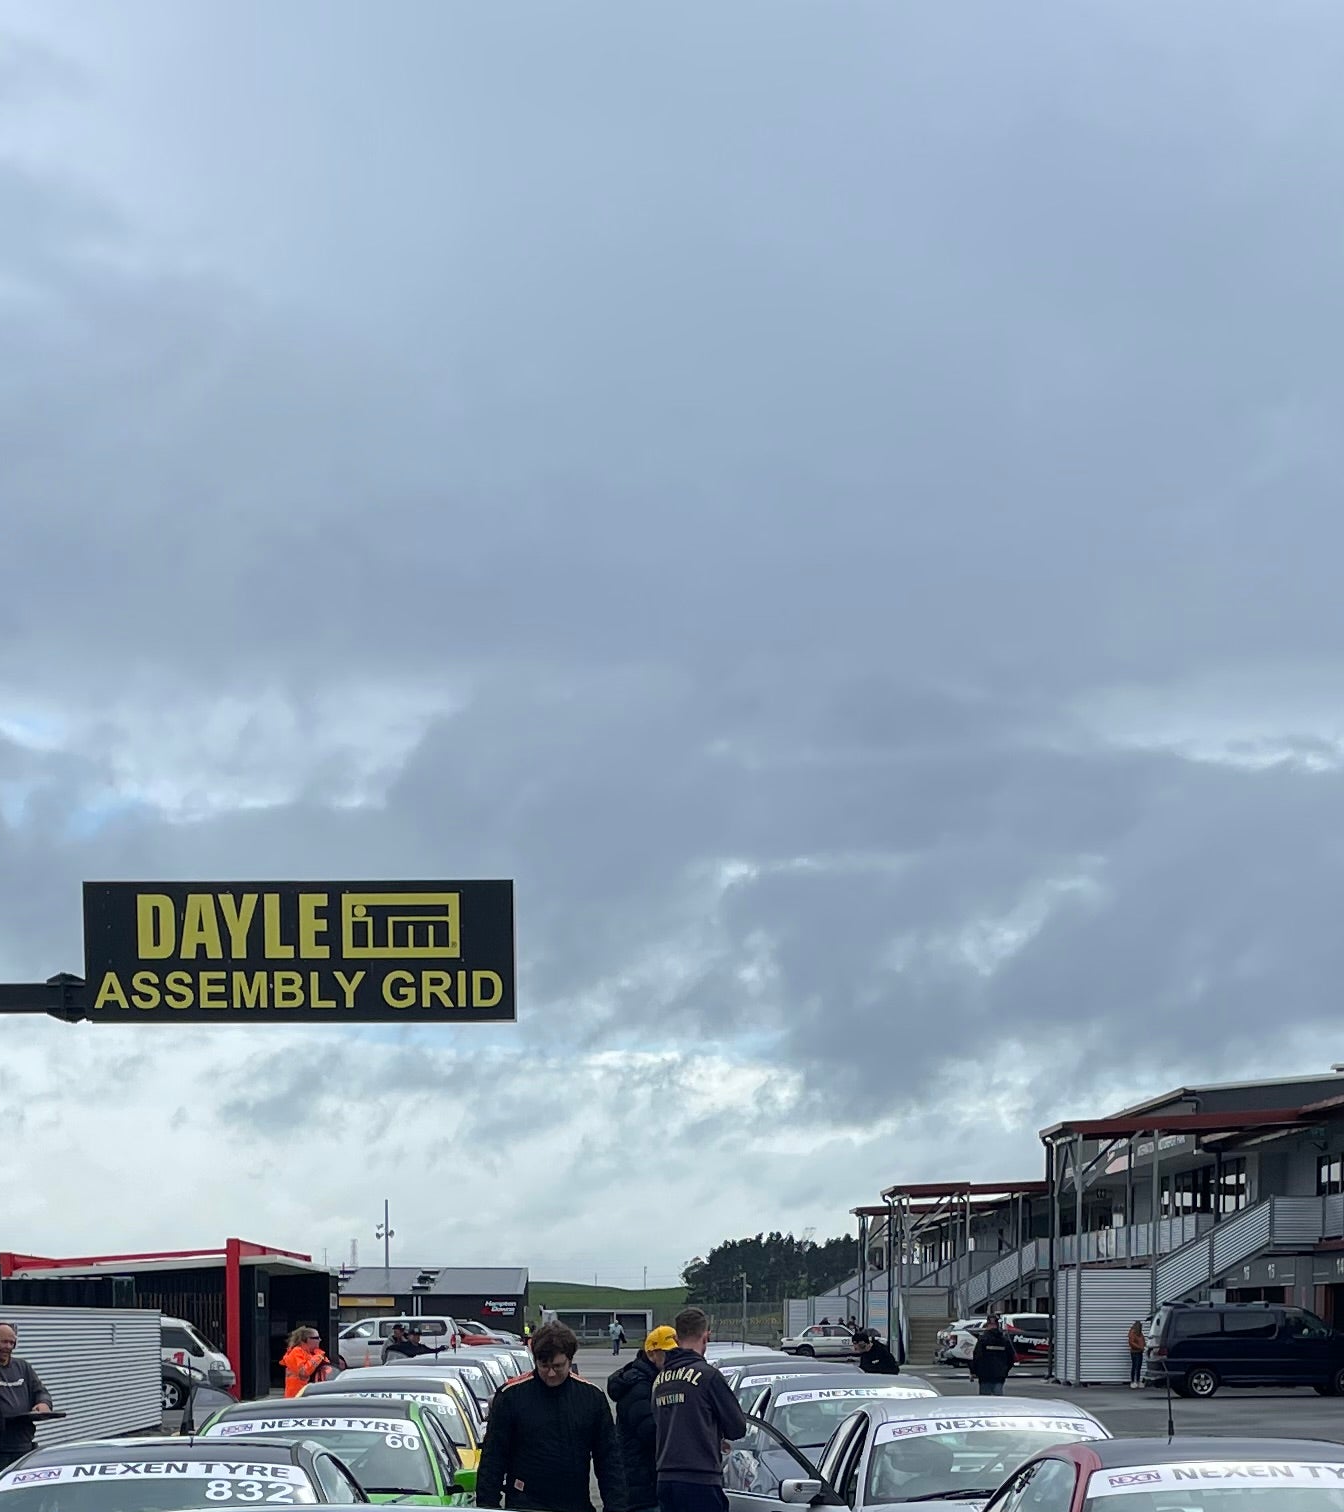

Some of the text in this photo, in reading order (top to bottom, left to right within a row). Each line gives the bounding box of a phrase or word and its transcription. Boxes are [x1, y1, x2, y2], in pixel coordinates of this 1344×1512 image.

[137, 892, 330, 959] DAYLE
[94, 970, 503, 1010] ASSEMBLY GRID
[261, 1419, 337, 1429] NEXEN
[345, 1419, 404, 1432] TYRE
[935, 1419, 1017, 1430] NEXEN
[385, 1434, 419, 1450] 60
[72, 1462, 188, 1478] NEXEN
[194, 1462, 290, 1479] TYRE
[1172, 1465, 1295, 1481] NEXEN
[204, 1479, 294, 1504] 832
